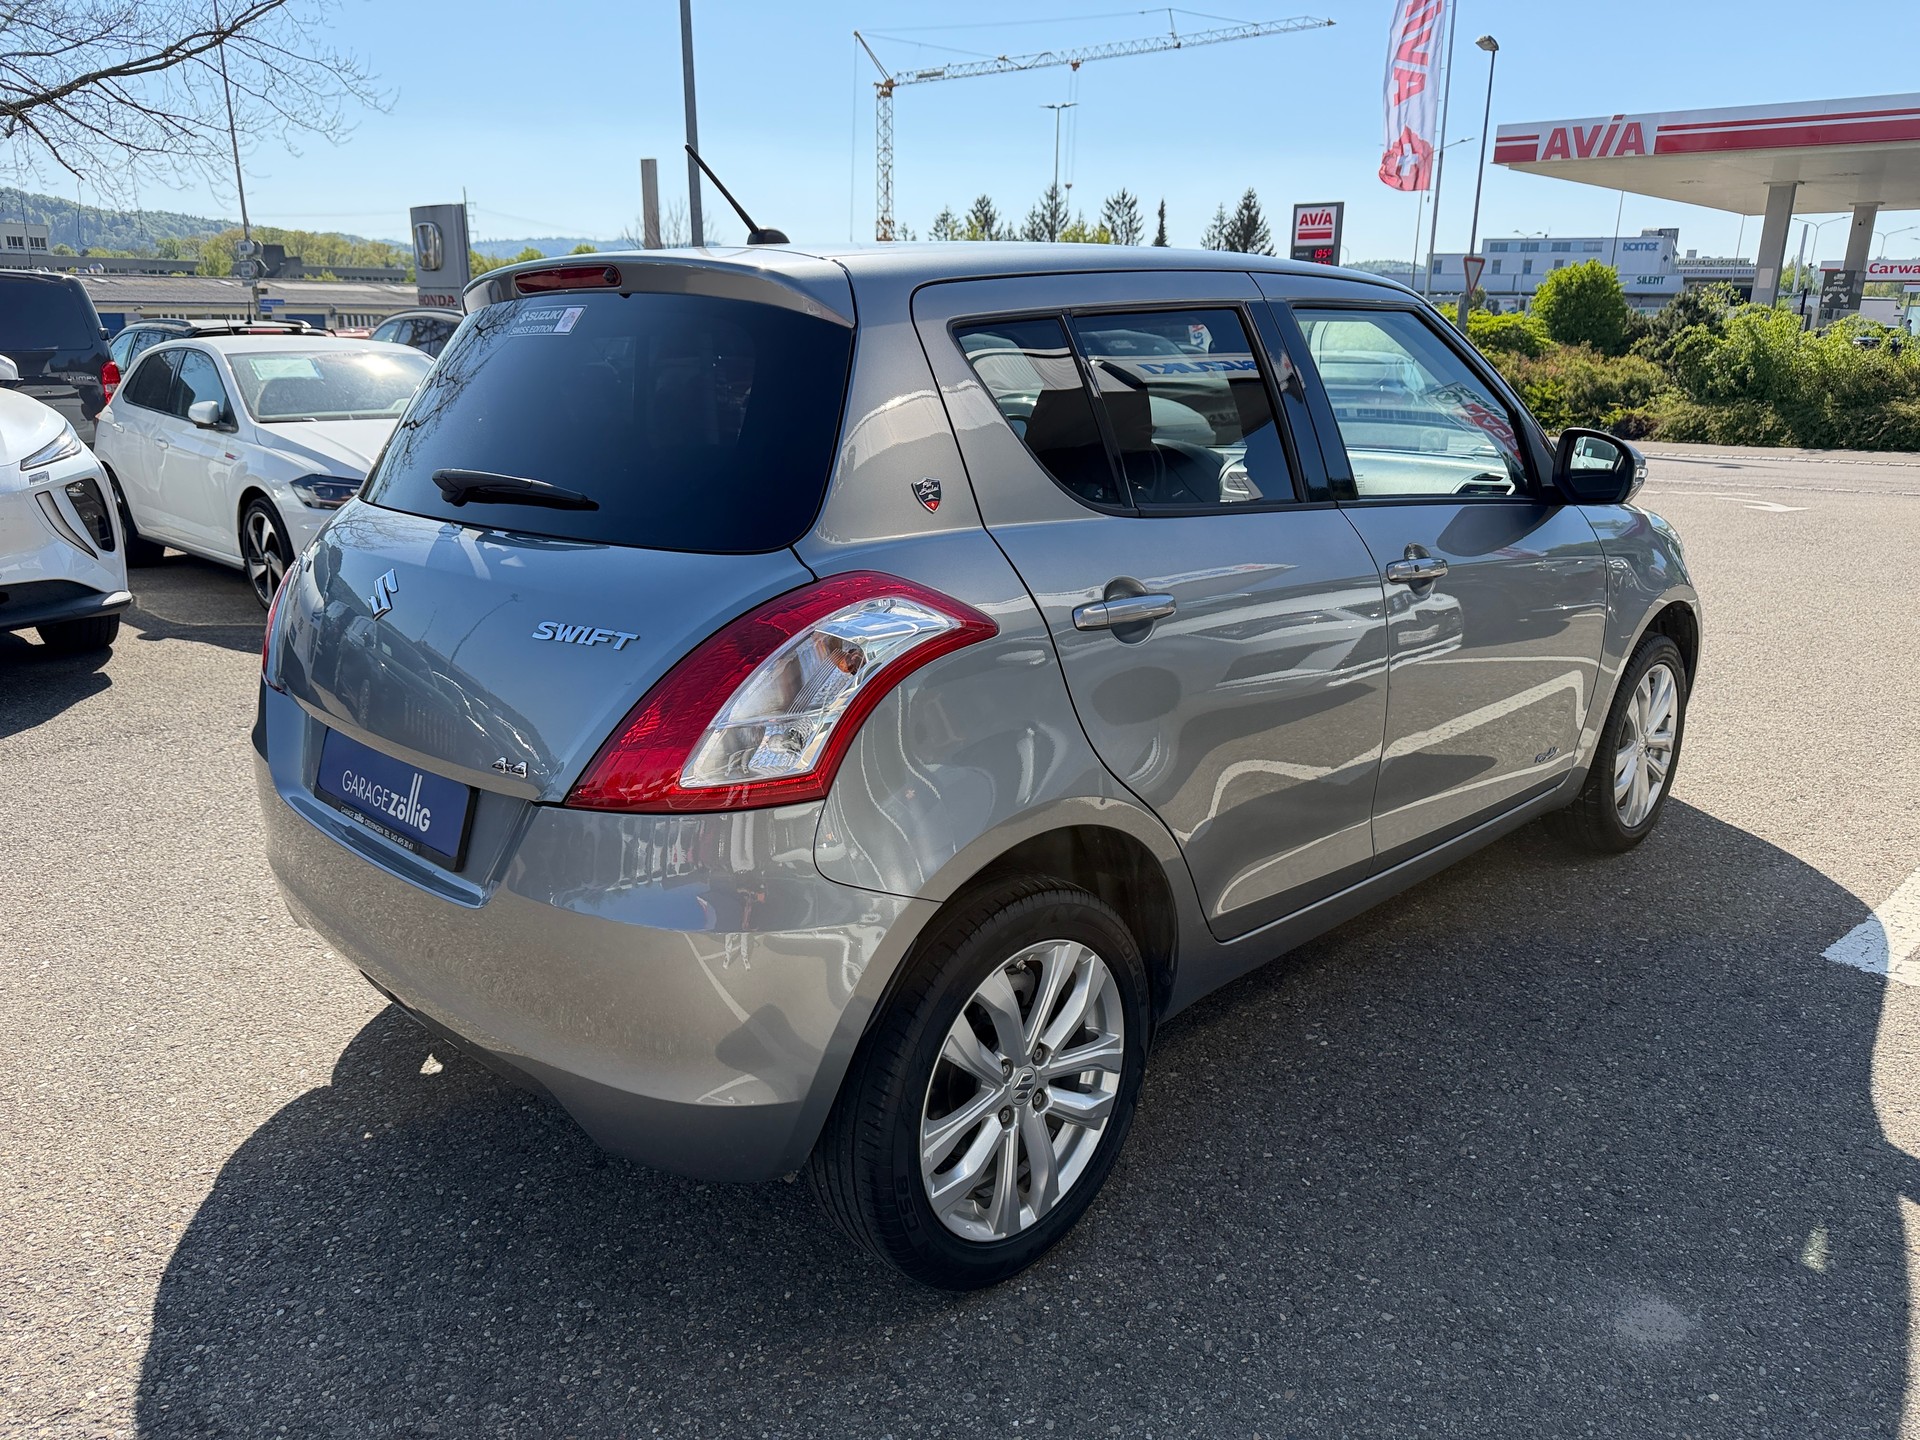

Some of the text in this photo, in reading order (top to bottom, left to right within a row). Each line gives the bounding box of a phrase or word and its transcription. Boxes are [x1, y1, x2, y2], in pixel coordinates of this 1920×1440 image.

[418, 295, 458, 306] HONDA
[527, 310, 564, 321] SUZUKI
[529, 325, 555, 333] EDITION
[532, 621, 640, 651] SWIFT
